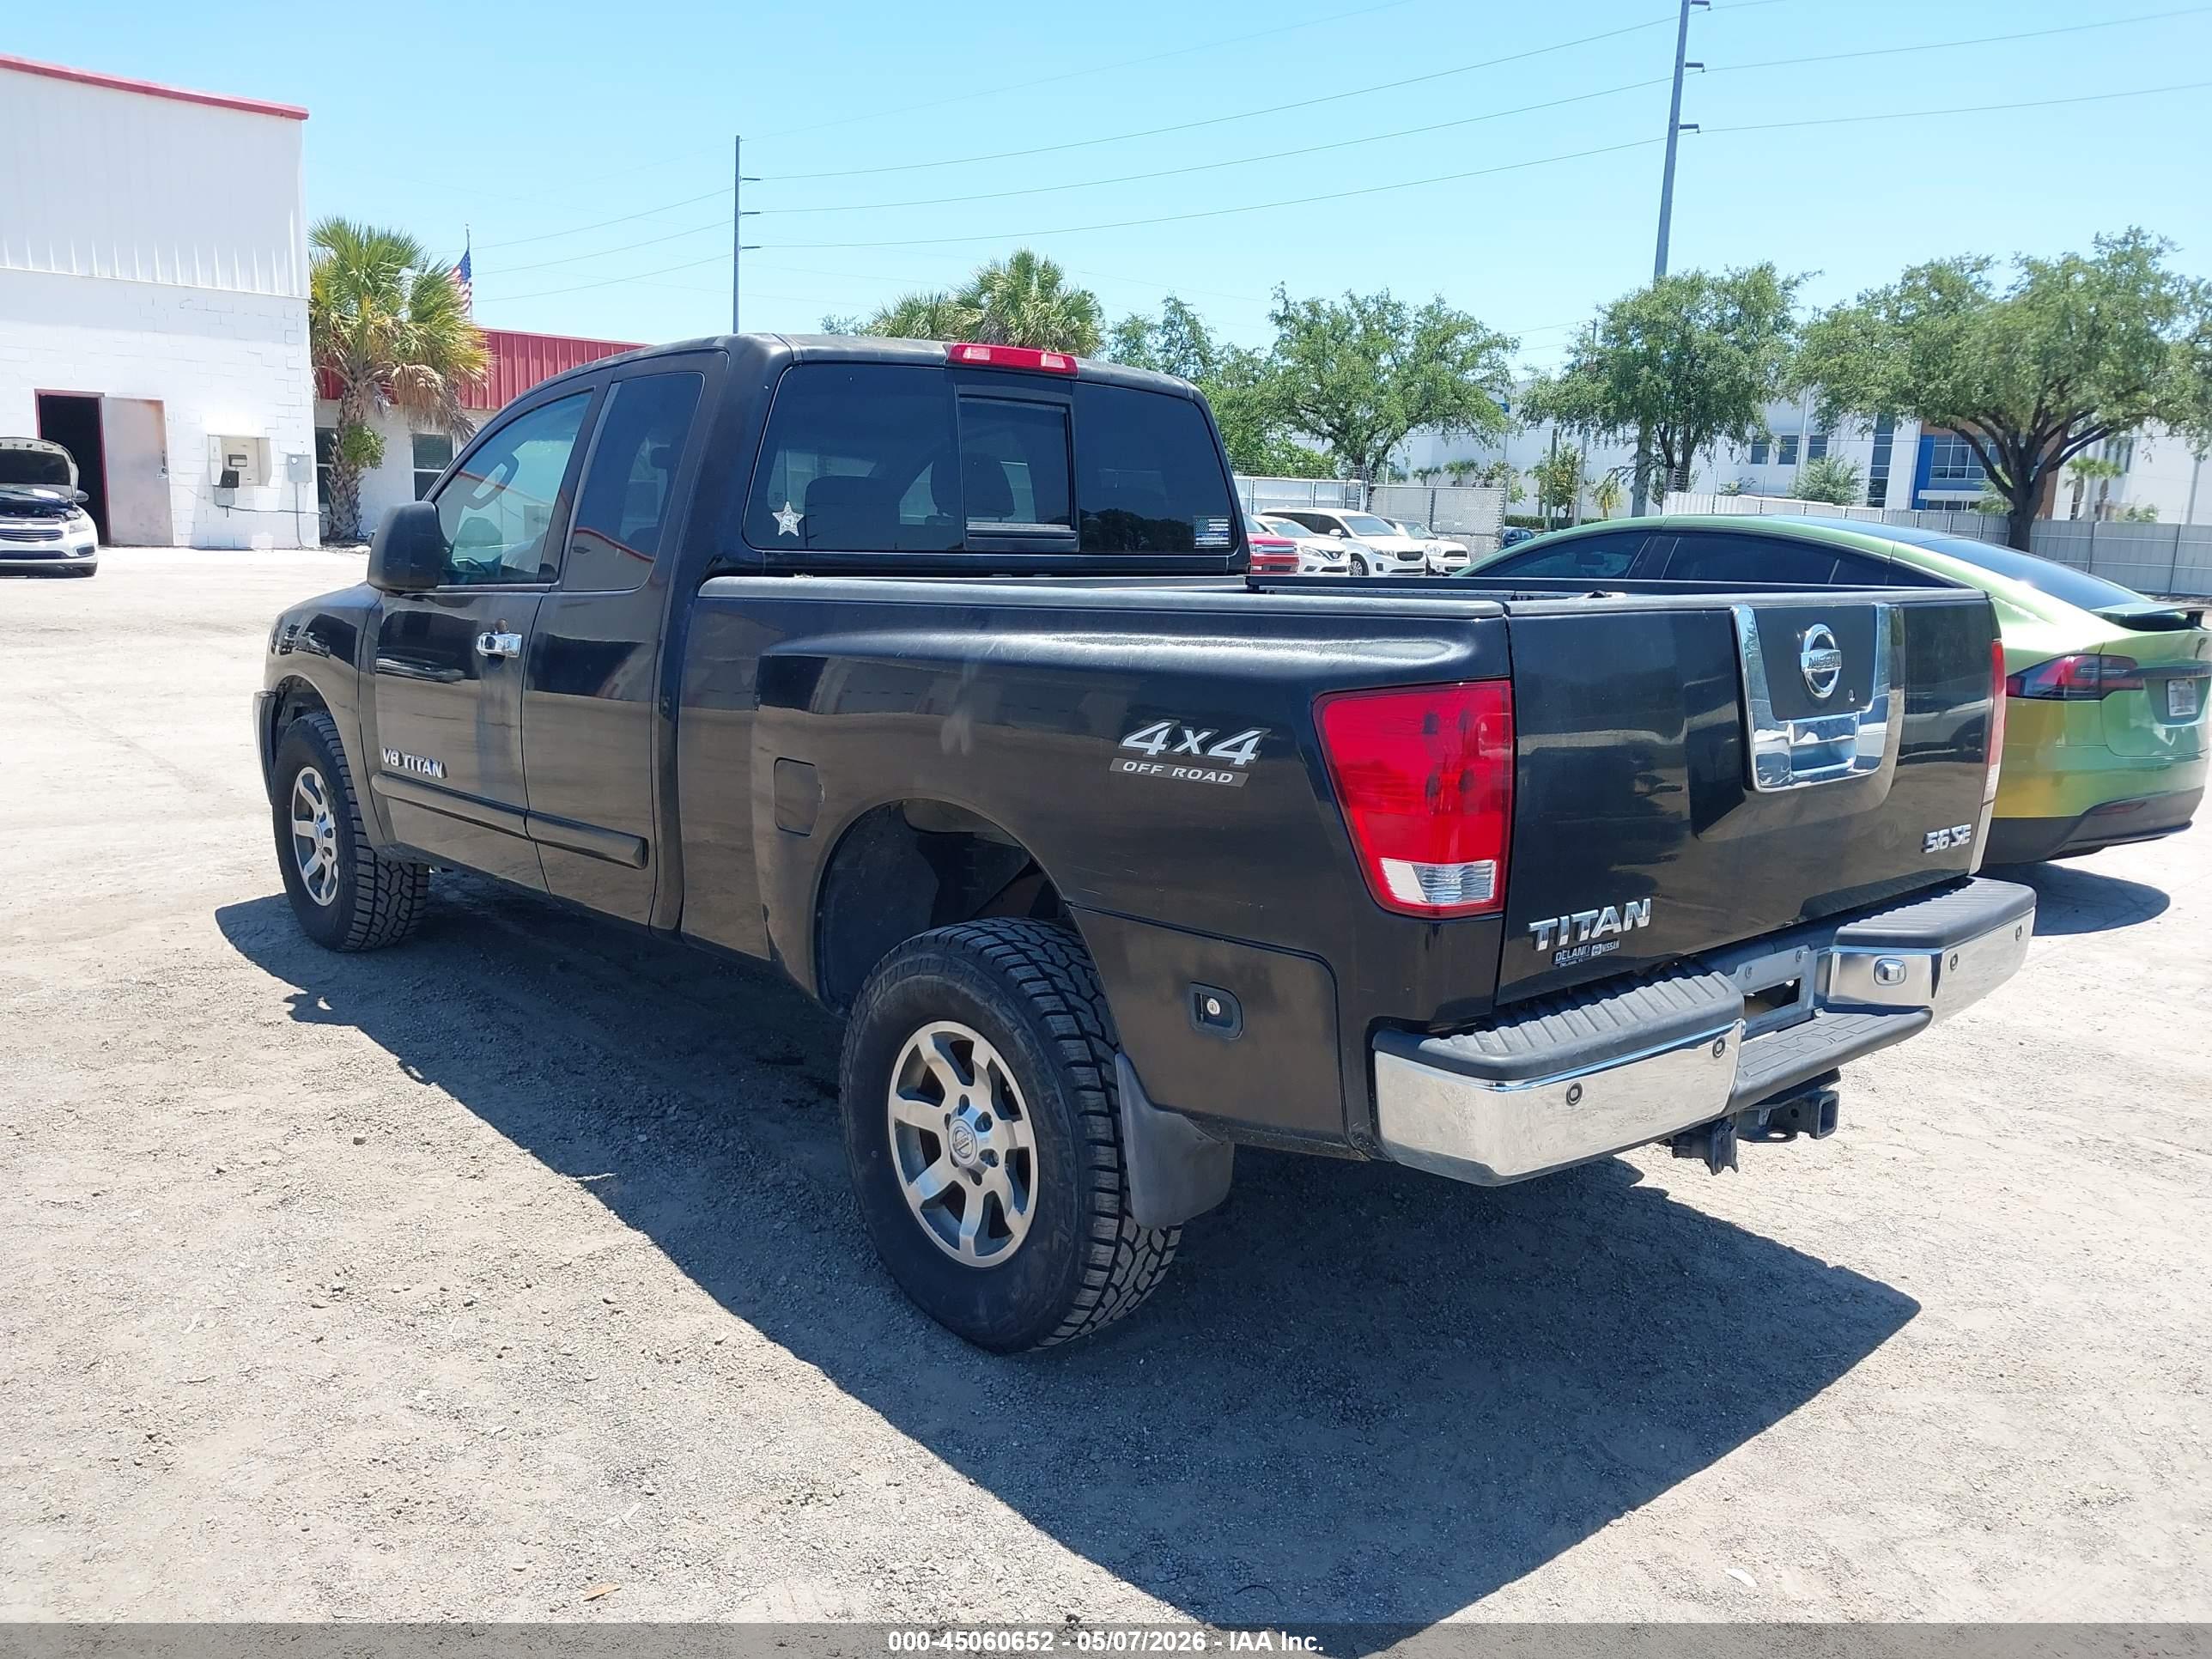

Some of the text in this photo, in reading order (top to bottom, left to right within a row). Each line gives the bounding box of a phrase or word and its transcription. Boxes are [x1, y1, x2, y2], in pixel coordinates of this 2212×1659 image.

[382, 747, 445, 779] V8 TITAN
[1122, 761, 1234, 783] OFF ROAD
[1528, 897, 1651, 952] TITAN
